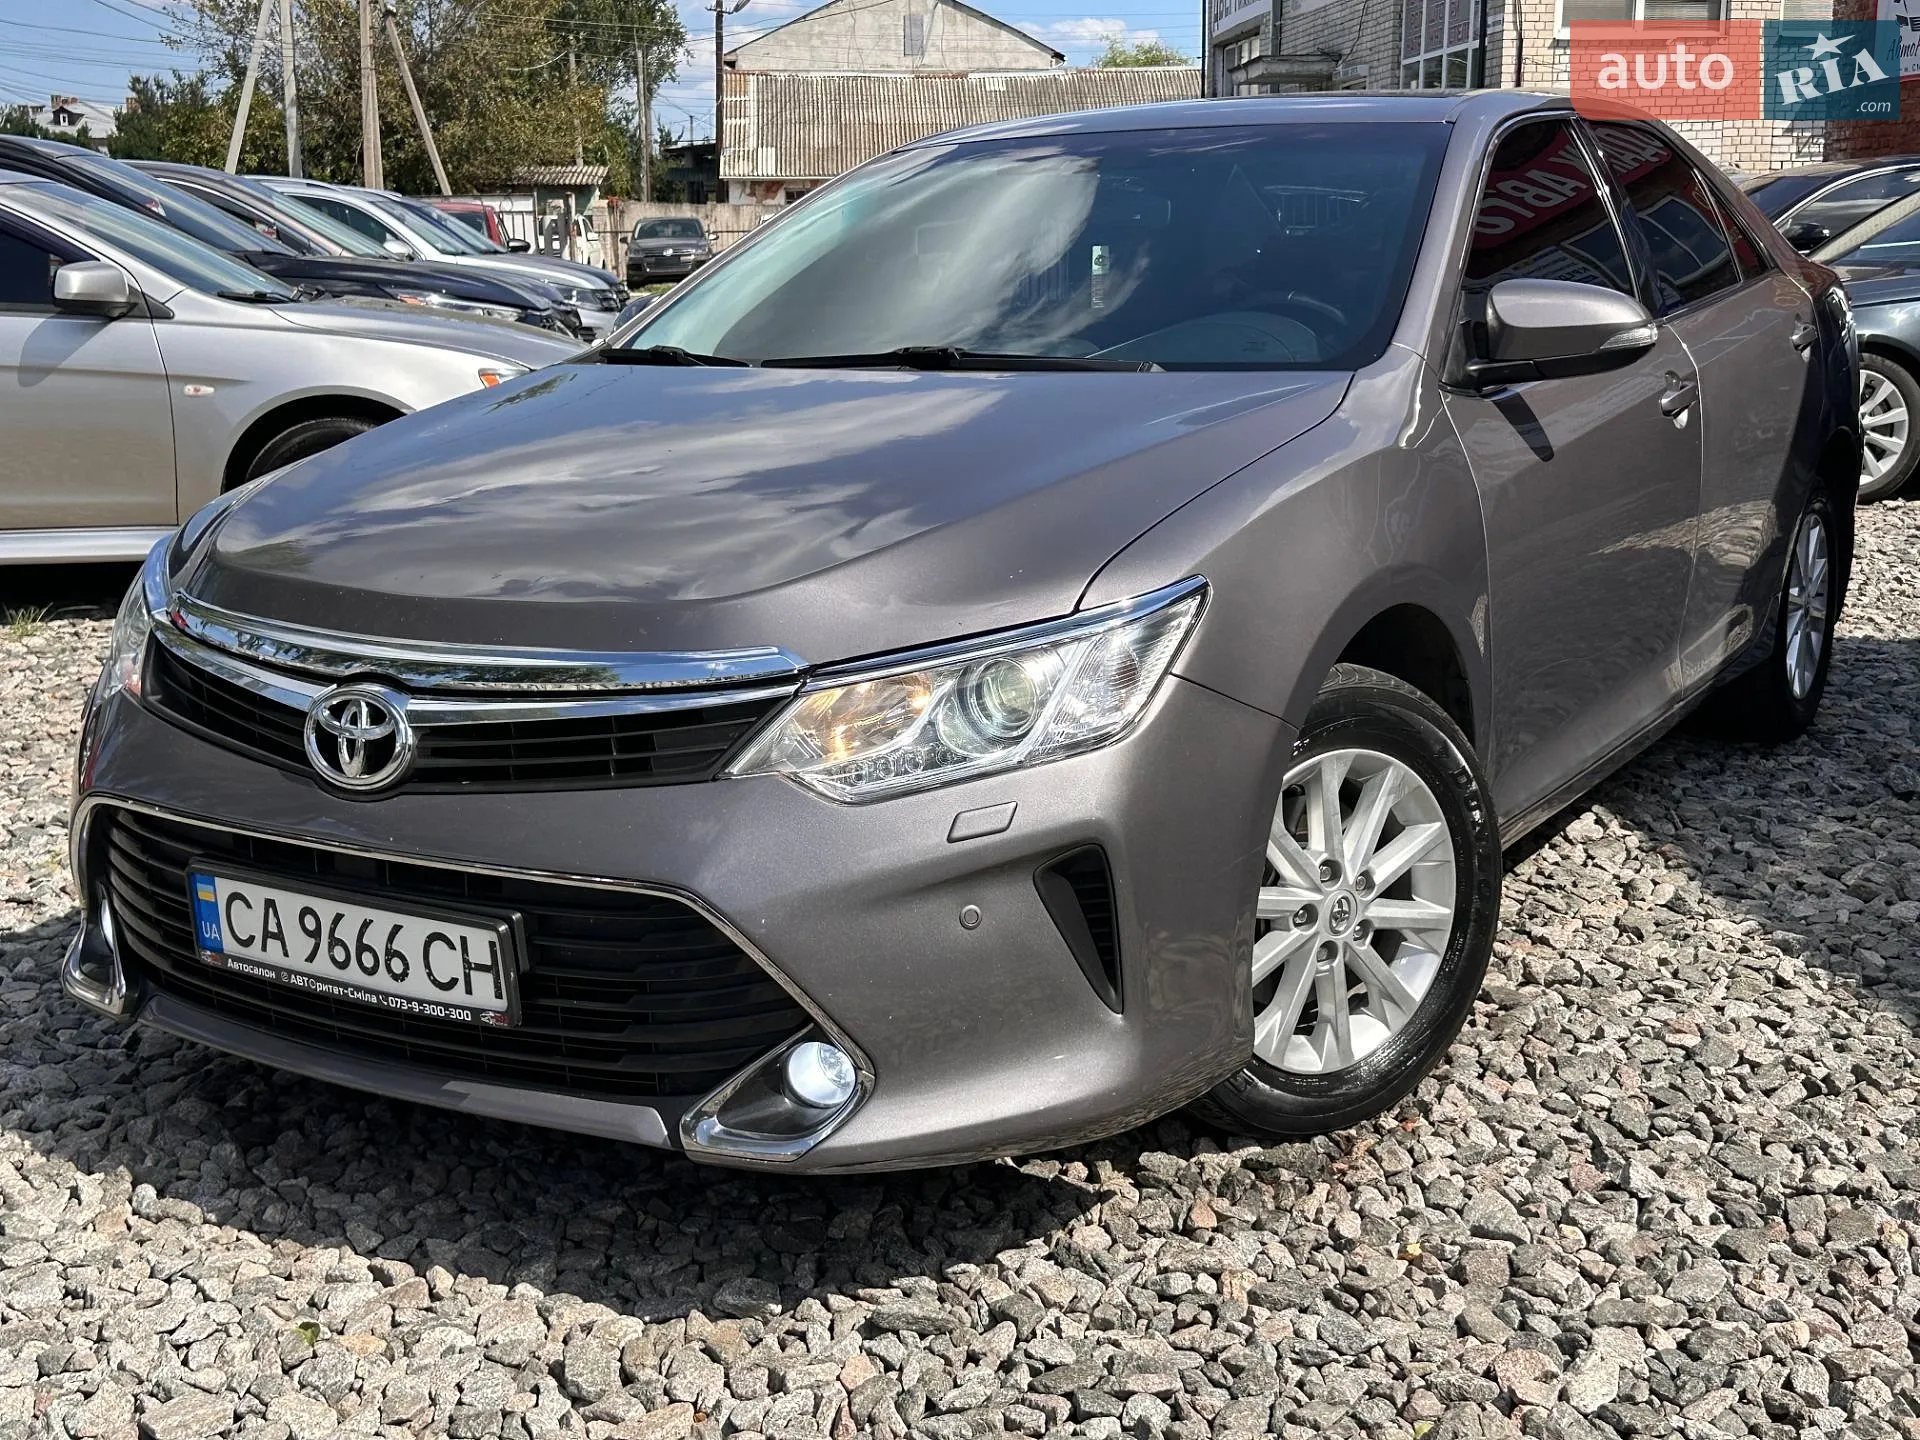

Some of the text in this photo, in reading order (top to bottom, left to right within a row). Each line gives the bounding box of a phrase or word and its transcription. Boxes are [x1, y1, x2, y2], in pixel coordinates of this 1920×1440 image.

[201, 920, 221, 941] UA
[225, 891, 504, 1000] CA 9666 CH
[227, 958, 276, 979] Автосалон
[388, 997, 472, 1021] 073-9-300-300
